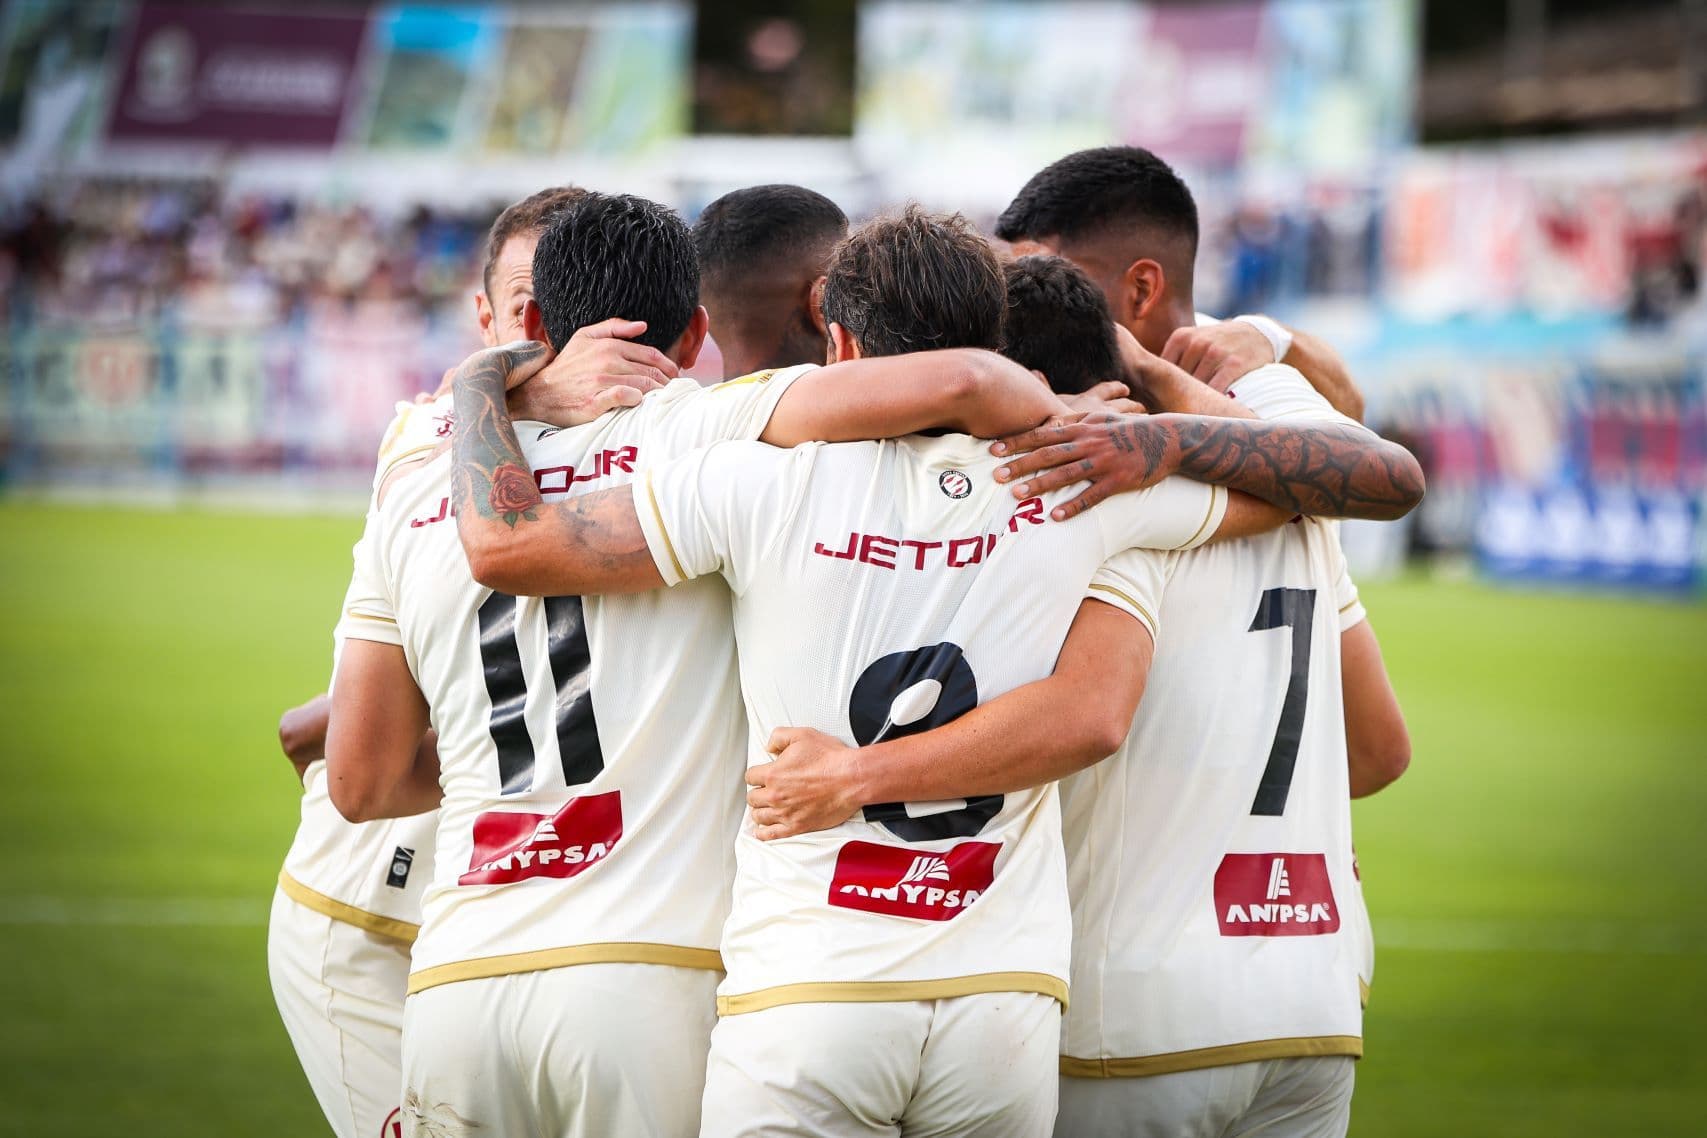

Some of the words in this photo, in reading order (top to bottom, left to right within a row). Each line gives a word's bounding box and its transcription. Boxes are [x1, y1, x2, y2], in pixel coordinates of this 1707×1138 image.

[411, 446, 638, 528] JOUR
[478, 591, 605, 796] 11
[849, 641, 1005, 842] 8
[1248, 587, 1317, 816] 7
[1225, 903, 1331, 923] ANYPSA
